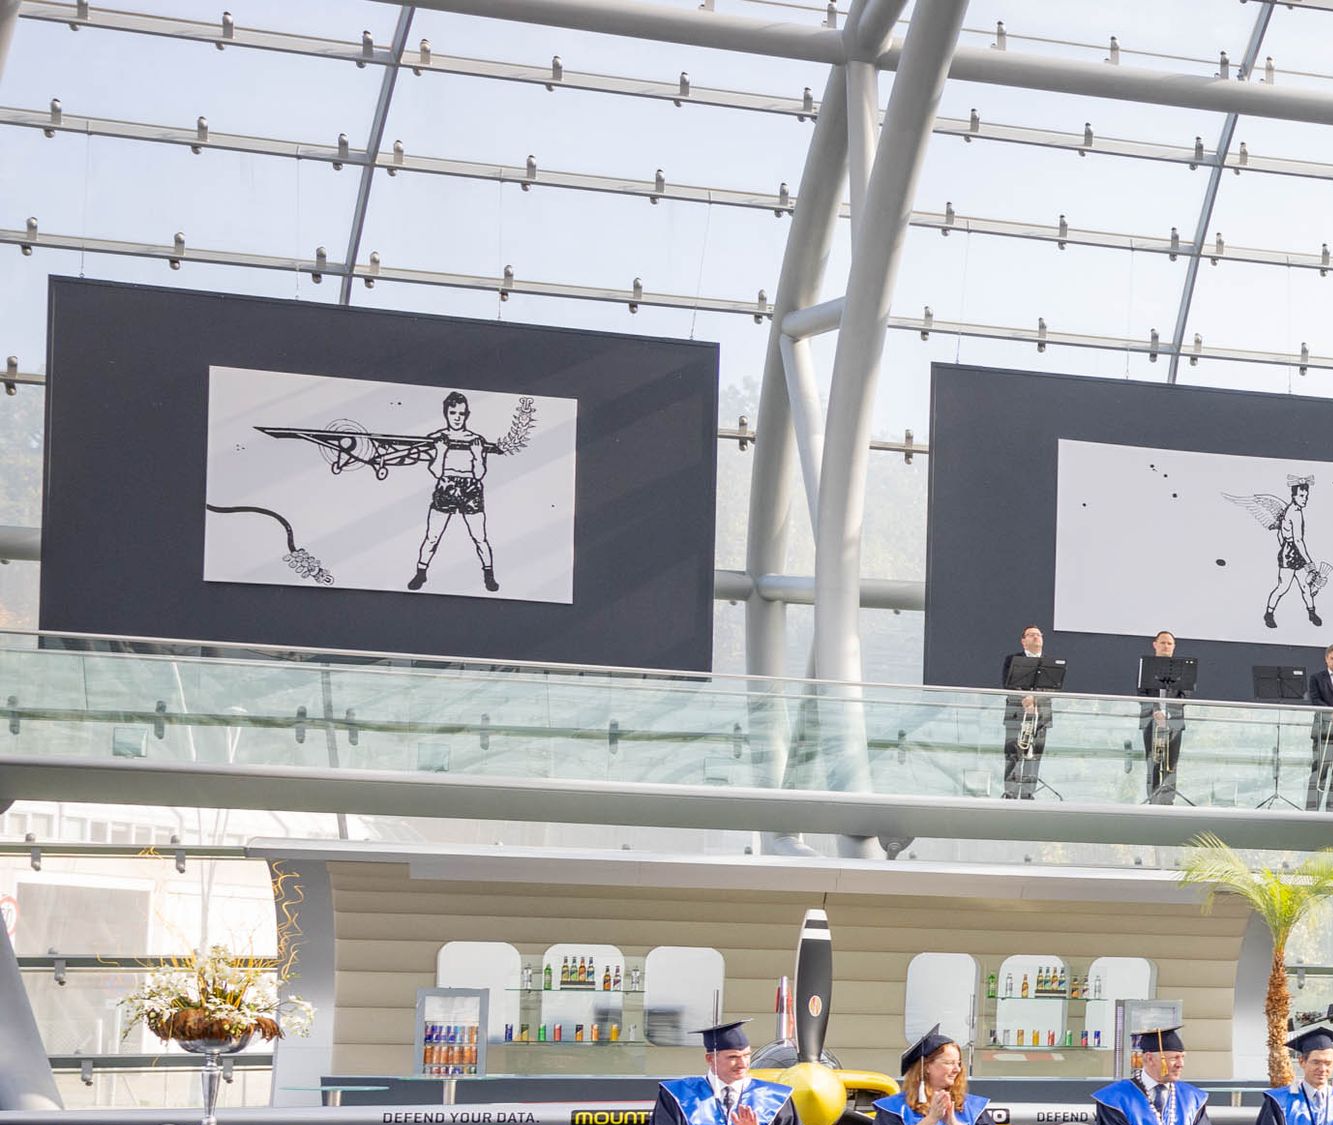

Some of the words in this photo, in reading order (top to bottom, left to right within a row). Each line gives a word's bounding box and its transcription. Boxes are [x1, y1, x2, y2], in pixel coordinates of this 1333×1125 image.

[382, 1112, 445, 1124] DEFEND
[450, 1112, 491, 1124] YOUR
[497, 1111, 540, 1124] DATA.
[575, 1111, 653, 1125] MOUNT
[1036, 1111, 1089, 1123] DEFEND
